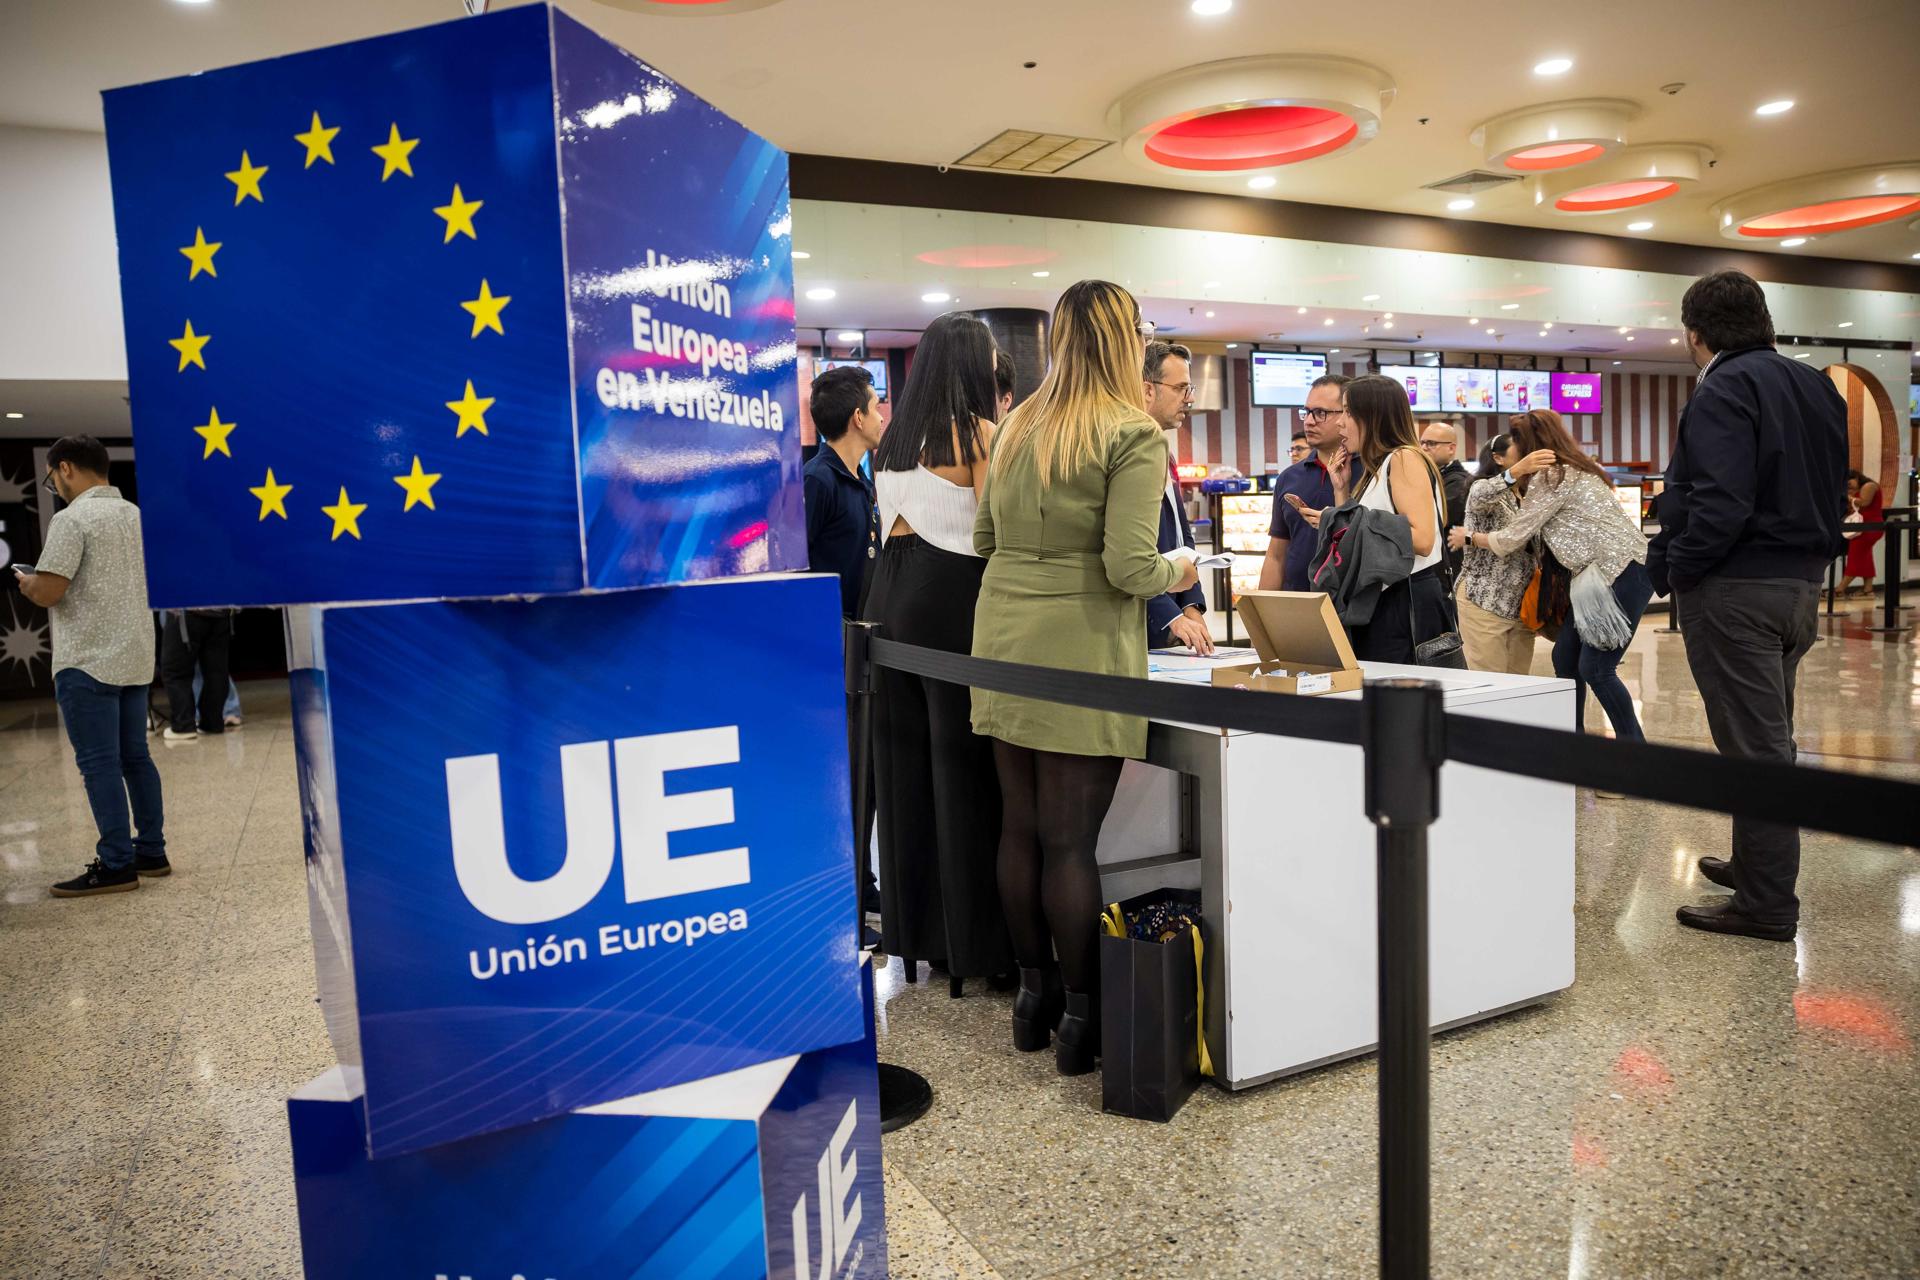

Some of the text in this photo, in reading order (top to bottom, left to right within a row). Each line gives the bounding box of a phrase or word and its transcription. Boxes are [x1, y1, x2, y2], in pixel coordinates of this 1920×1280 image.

[631, 303, 749, 377] Europea
[596, 367, 784, 432] en Venezuela
[445, 725, 751, 925] UE
[469, 908, 748, 980] Unión Europea
[792, 1097, 863, 1280] UE
